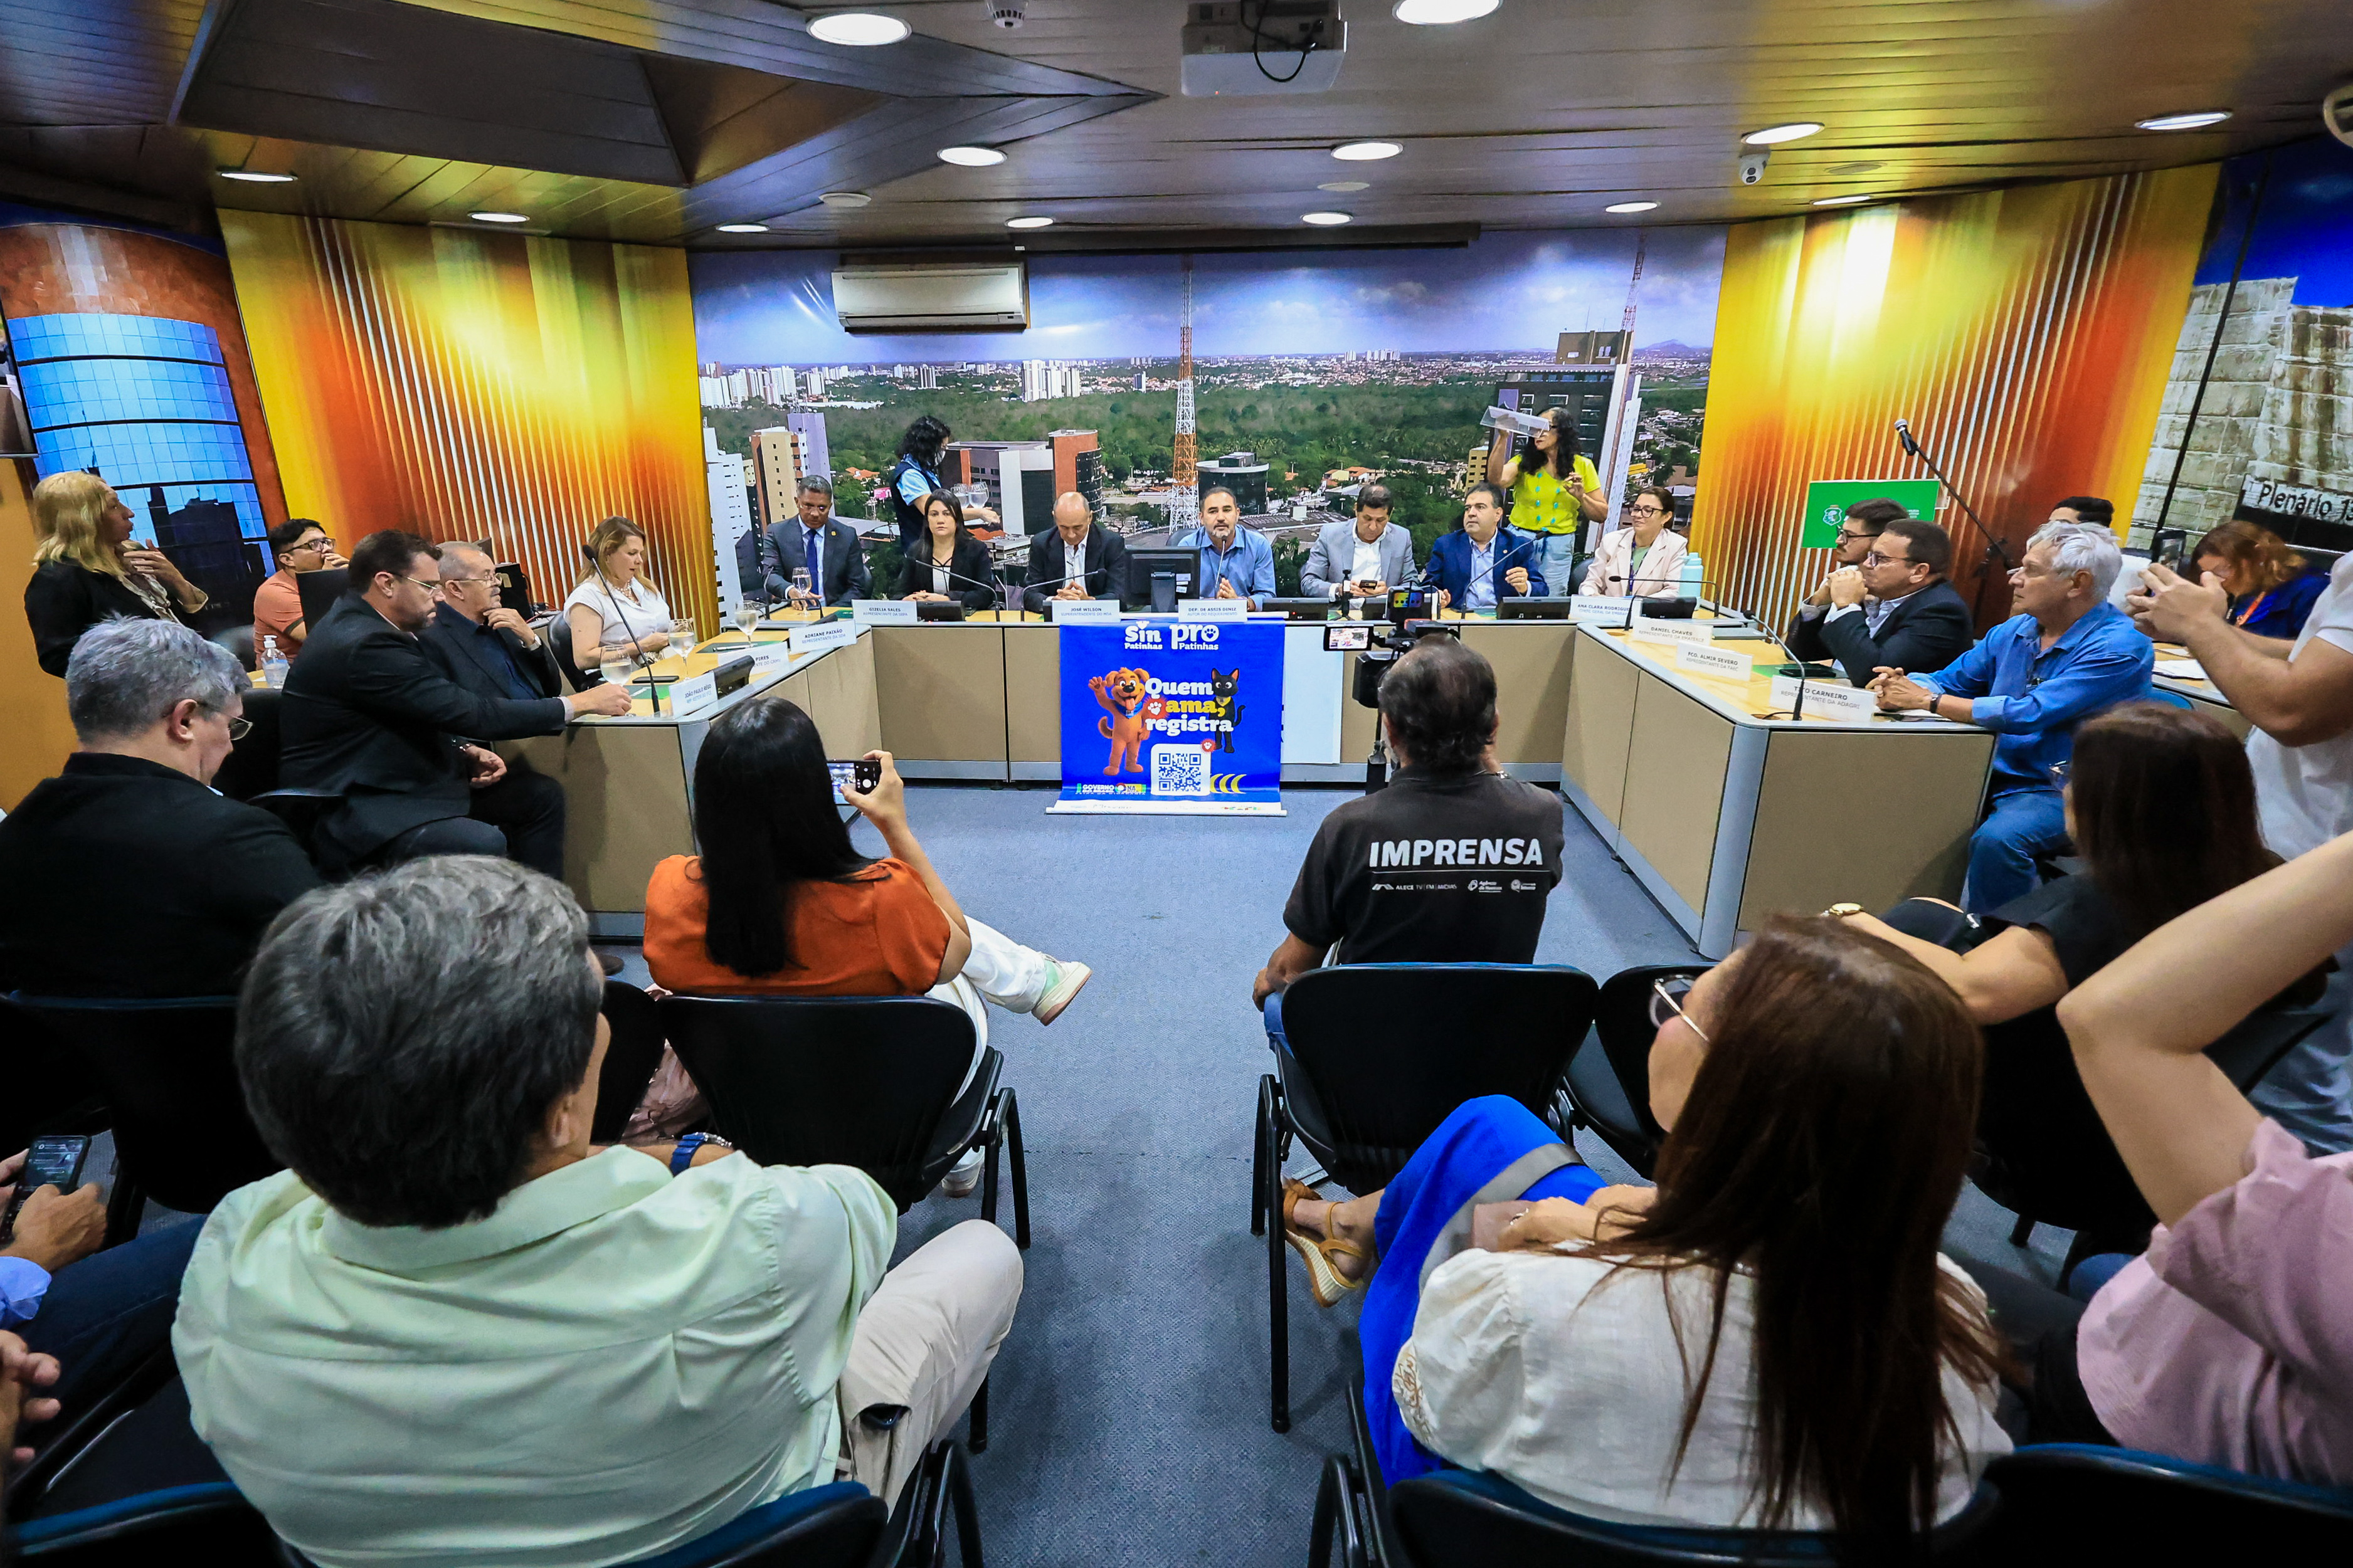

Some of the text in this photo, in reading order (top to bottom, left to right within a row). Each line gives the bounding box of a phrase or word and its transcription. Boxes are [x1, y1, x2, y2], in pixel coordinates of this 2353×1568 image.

[2258, 481, 2332, 517] Plenário
[801, 635, 832, 644] REPRESENTANTE
[1125, 621, 1220, 650] Sin pro
[1639, 630, 1673, 638] REPRESENTANTE
[1717, 658, 1738, 666] SEVERO
[1145, 678, 1214, 699] Quem
[1811, 689, 1848, 700] CARNEIRO
[1165, 700, 1226, 717] ama,
[1145, 714, 1234, 737] registra
[1369, 838, 1543, 868] IMPRENSA
